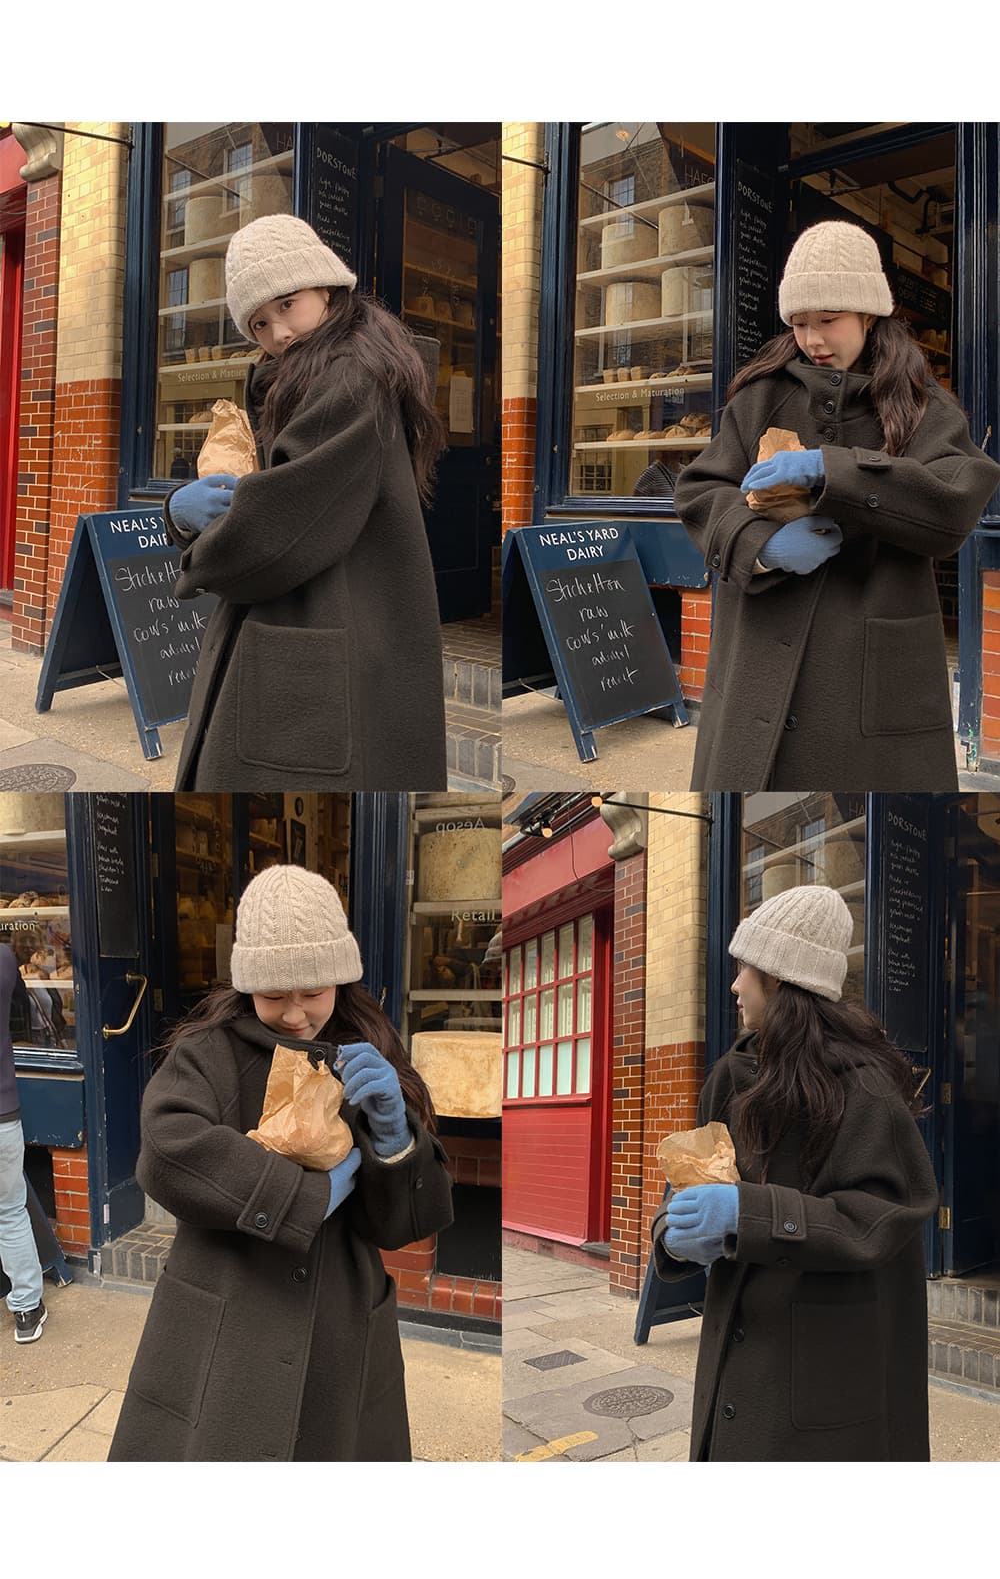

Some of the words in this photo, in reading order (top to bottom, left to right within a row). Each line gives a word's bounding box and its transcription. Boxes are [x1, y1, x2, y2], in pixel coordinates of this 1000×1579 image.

[316, 147, 358, 180] DORSTONE
[738, 181, 775, 213] DORSTONE
[177, 372, 210, 383] Selection
[595, 391, 630, 402] Selection
[631, 389, 638, 399] &
[640, 387, 685, 398] Maturation
[109, 517, 158, 534] NEAL'S
[138, 533, 168, 548] DAI
[539, 530, 585, 547] NEAL'S
[585, 527, 620, 542] YARD
[567, 545, 605, 562] DAIRY
[148, 596, 180, 613] raw
[578, 605, 609, 622] raw
[888, 811, 927, 841] DORSTONE
[451, 909, 496, 922] Retail
